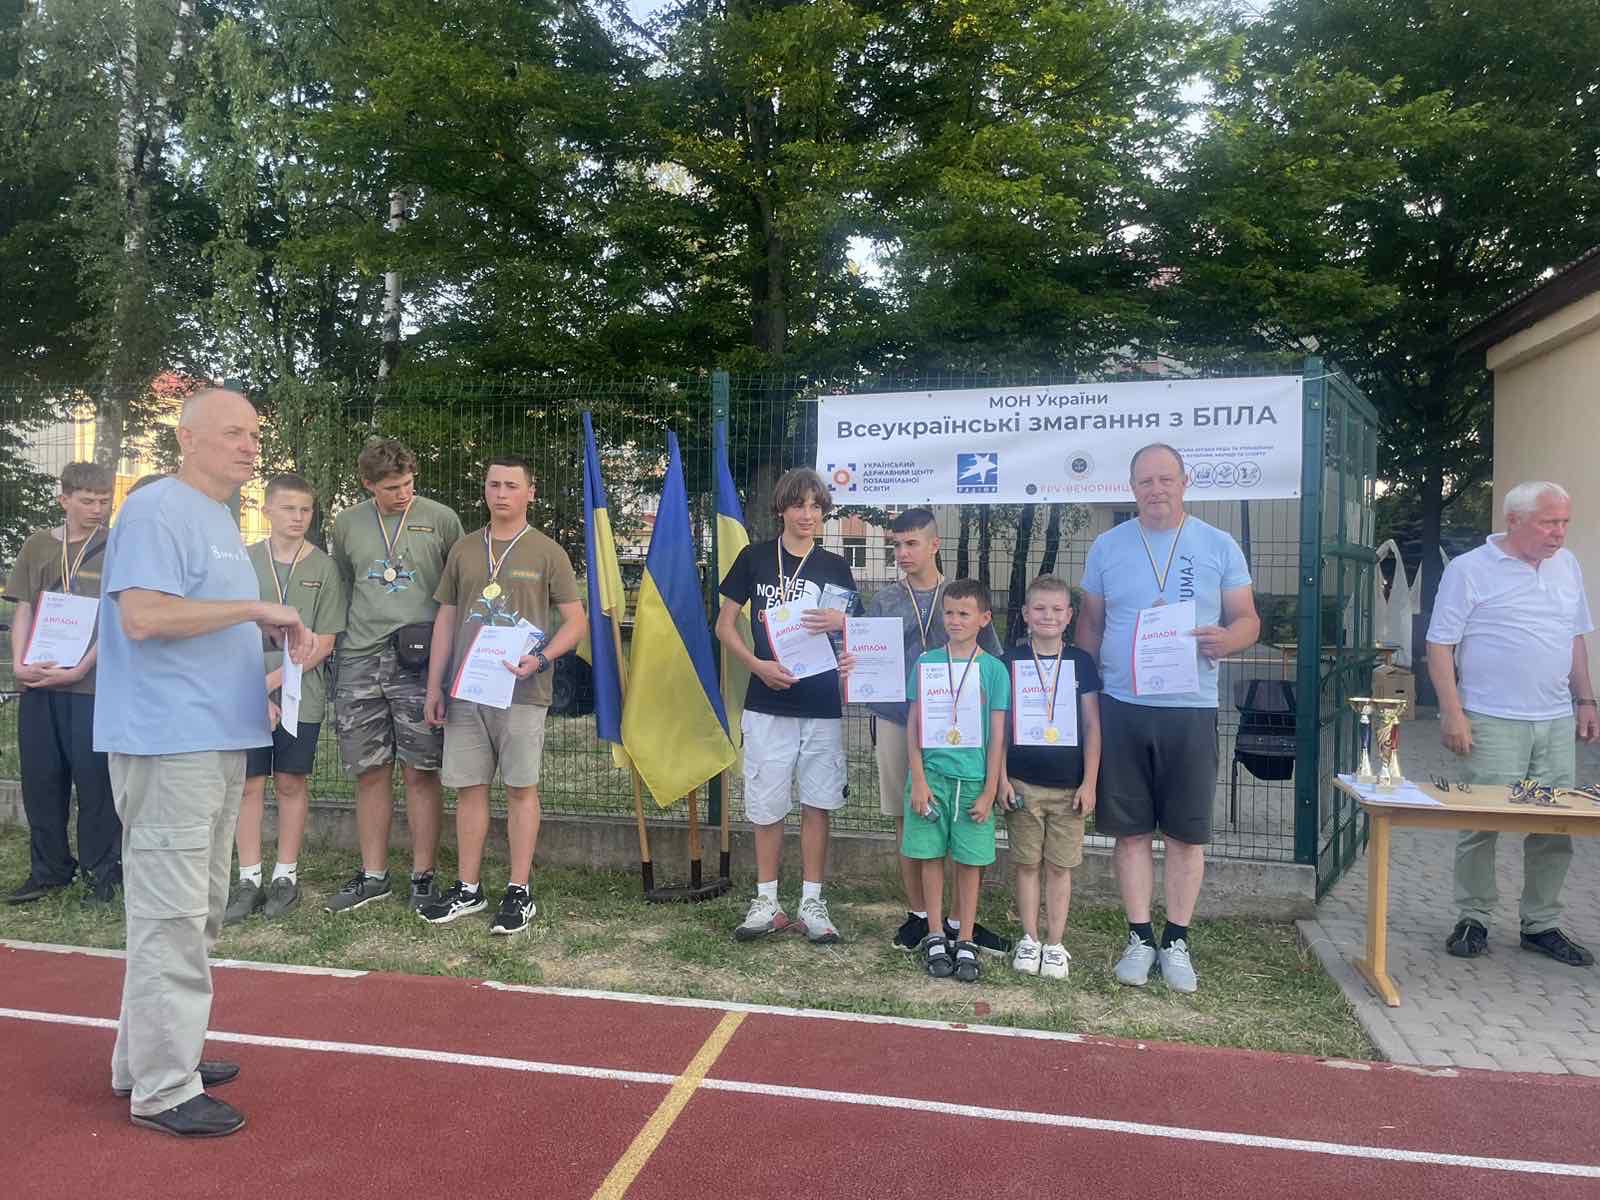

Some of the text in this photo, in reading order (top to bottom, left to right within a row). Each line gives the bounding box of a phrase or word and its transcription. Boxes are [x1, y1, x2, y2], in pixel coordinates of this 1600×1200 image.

[989, 391, 1109, 409] МОН України
[836, 405, 1278, 440] Всеукраїнські змагання з БПЛА
[1180, 566, 1195, 602] UMA
[852, 644, 888, 653] ДИПЛОМ
